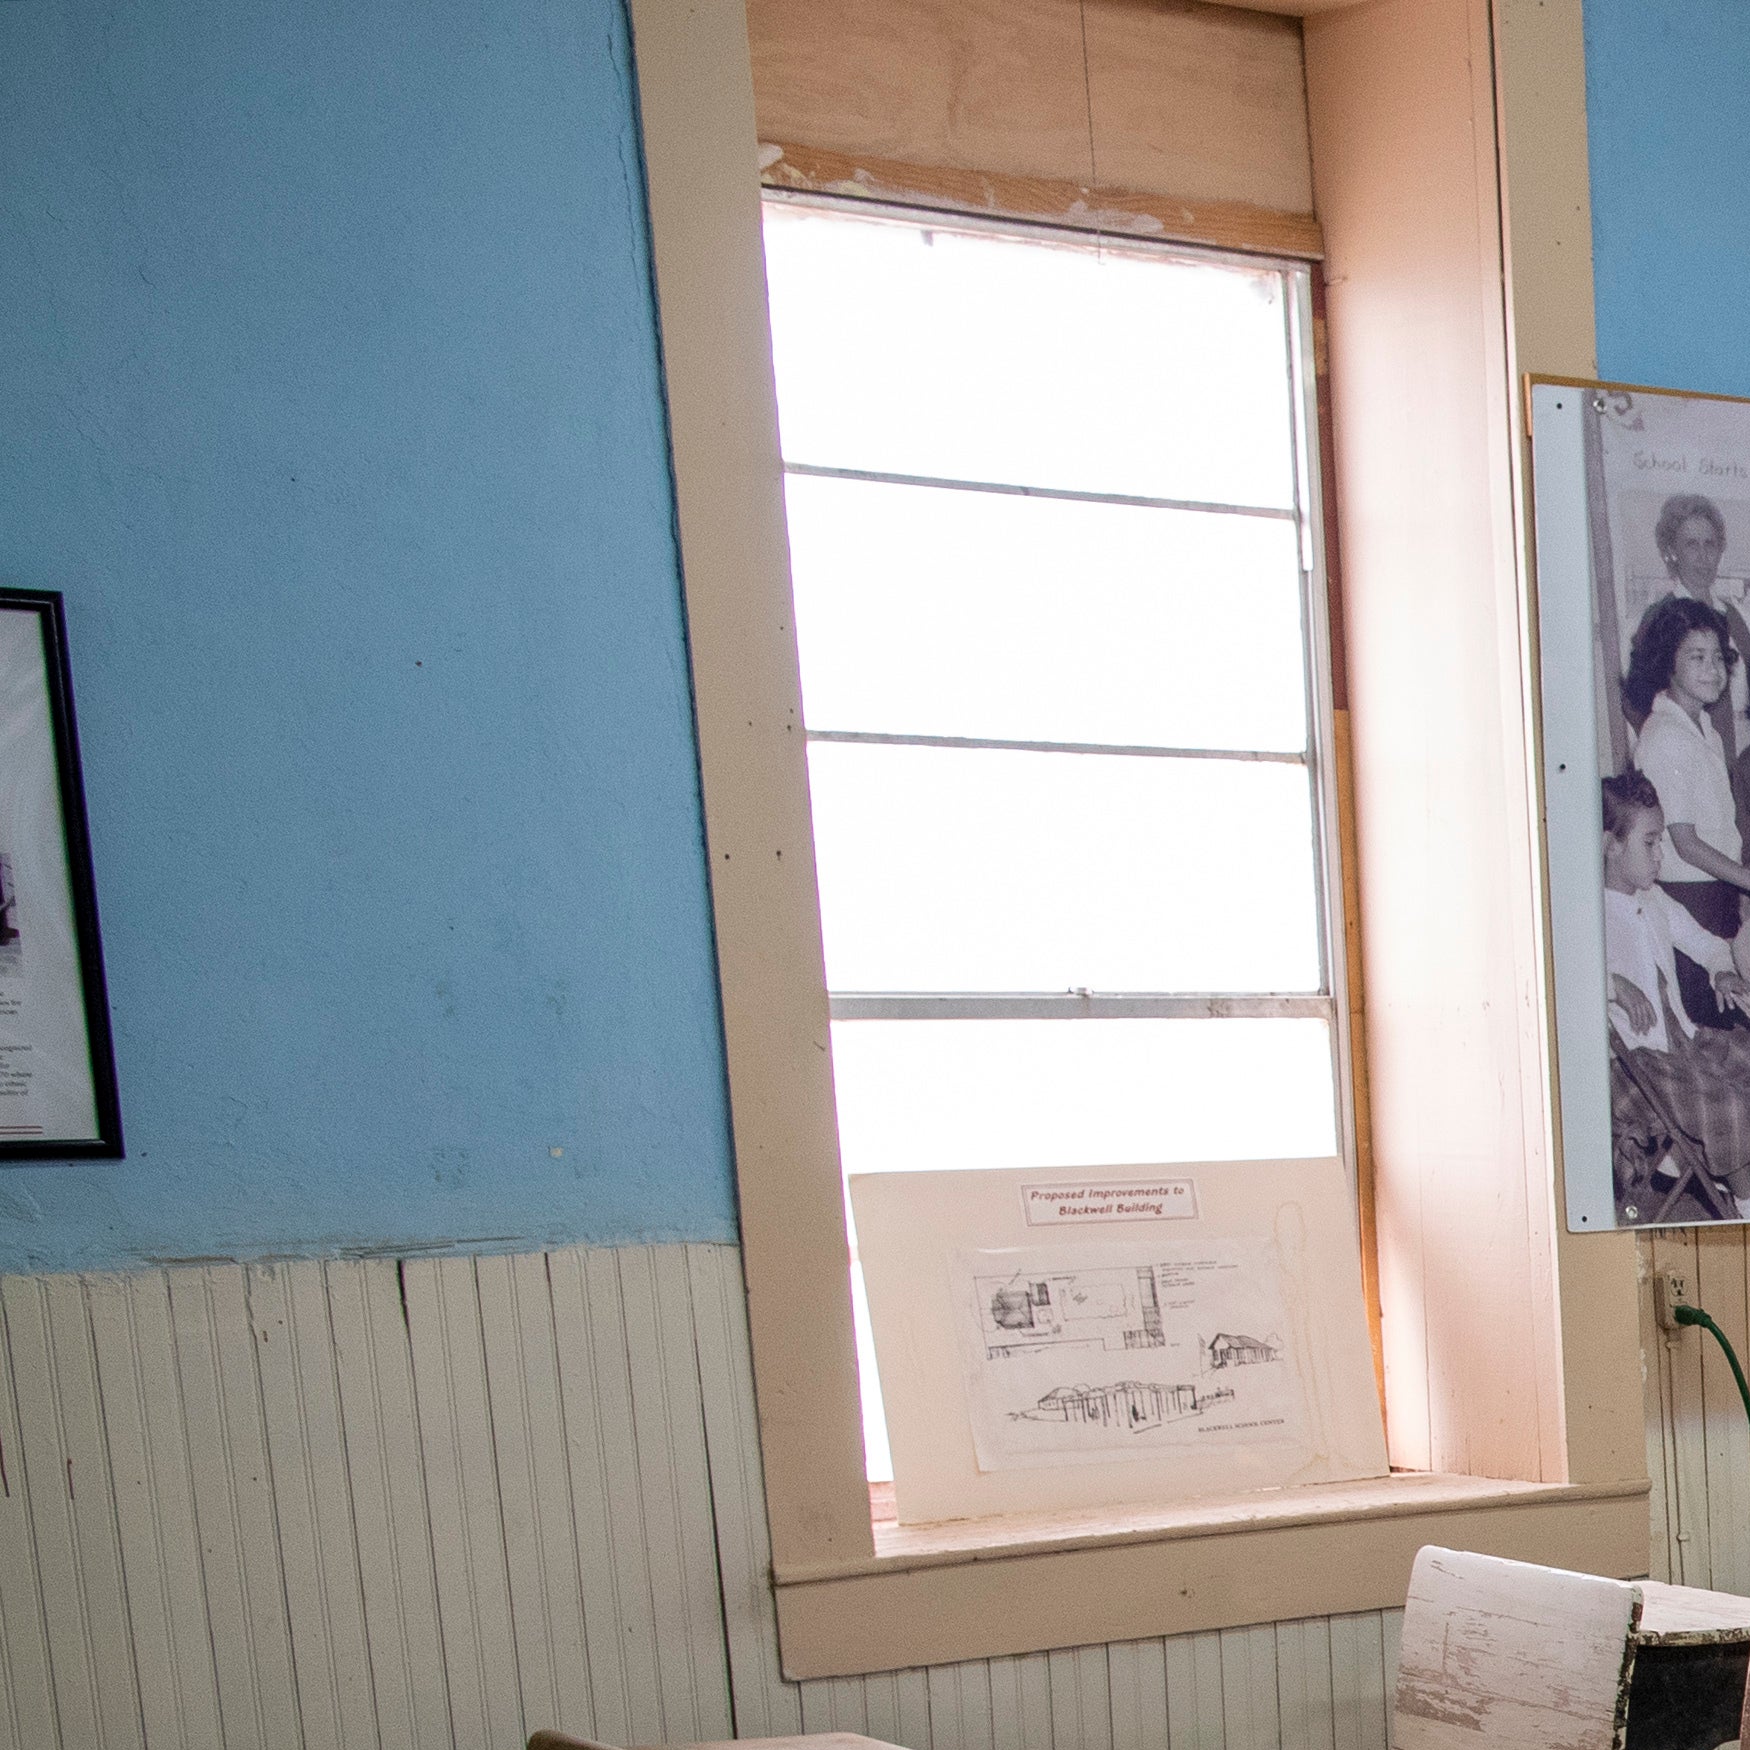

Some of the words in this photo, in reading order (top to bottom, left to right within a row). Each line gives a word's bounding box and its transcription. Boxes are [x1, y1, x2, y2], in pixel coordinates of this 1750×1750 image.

[1632, 449, 1687, 473] School
[1699, 457, 1749, 479] Starts
[1030, 1189, 1085, 1202] Proposed
[1173, 1186, 1185, 1195] to
[1058, 1204, 1113, 1216] Blackwell
[1116, 1202, 1163, 1215] Building
[1198, 1424, 1234, 1432] BLACKWELL
[1260, 1418, 1285, 1426] CENTER
